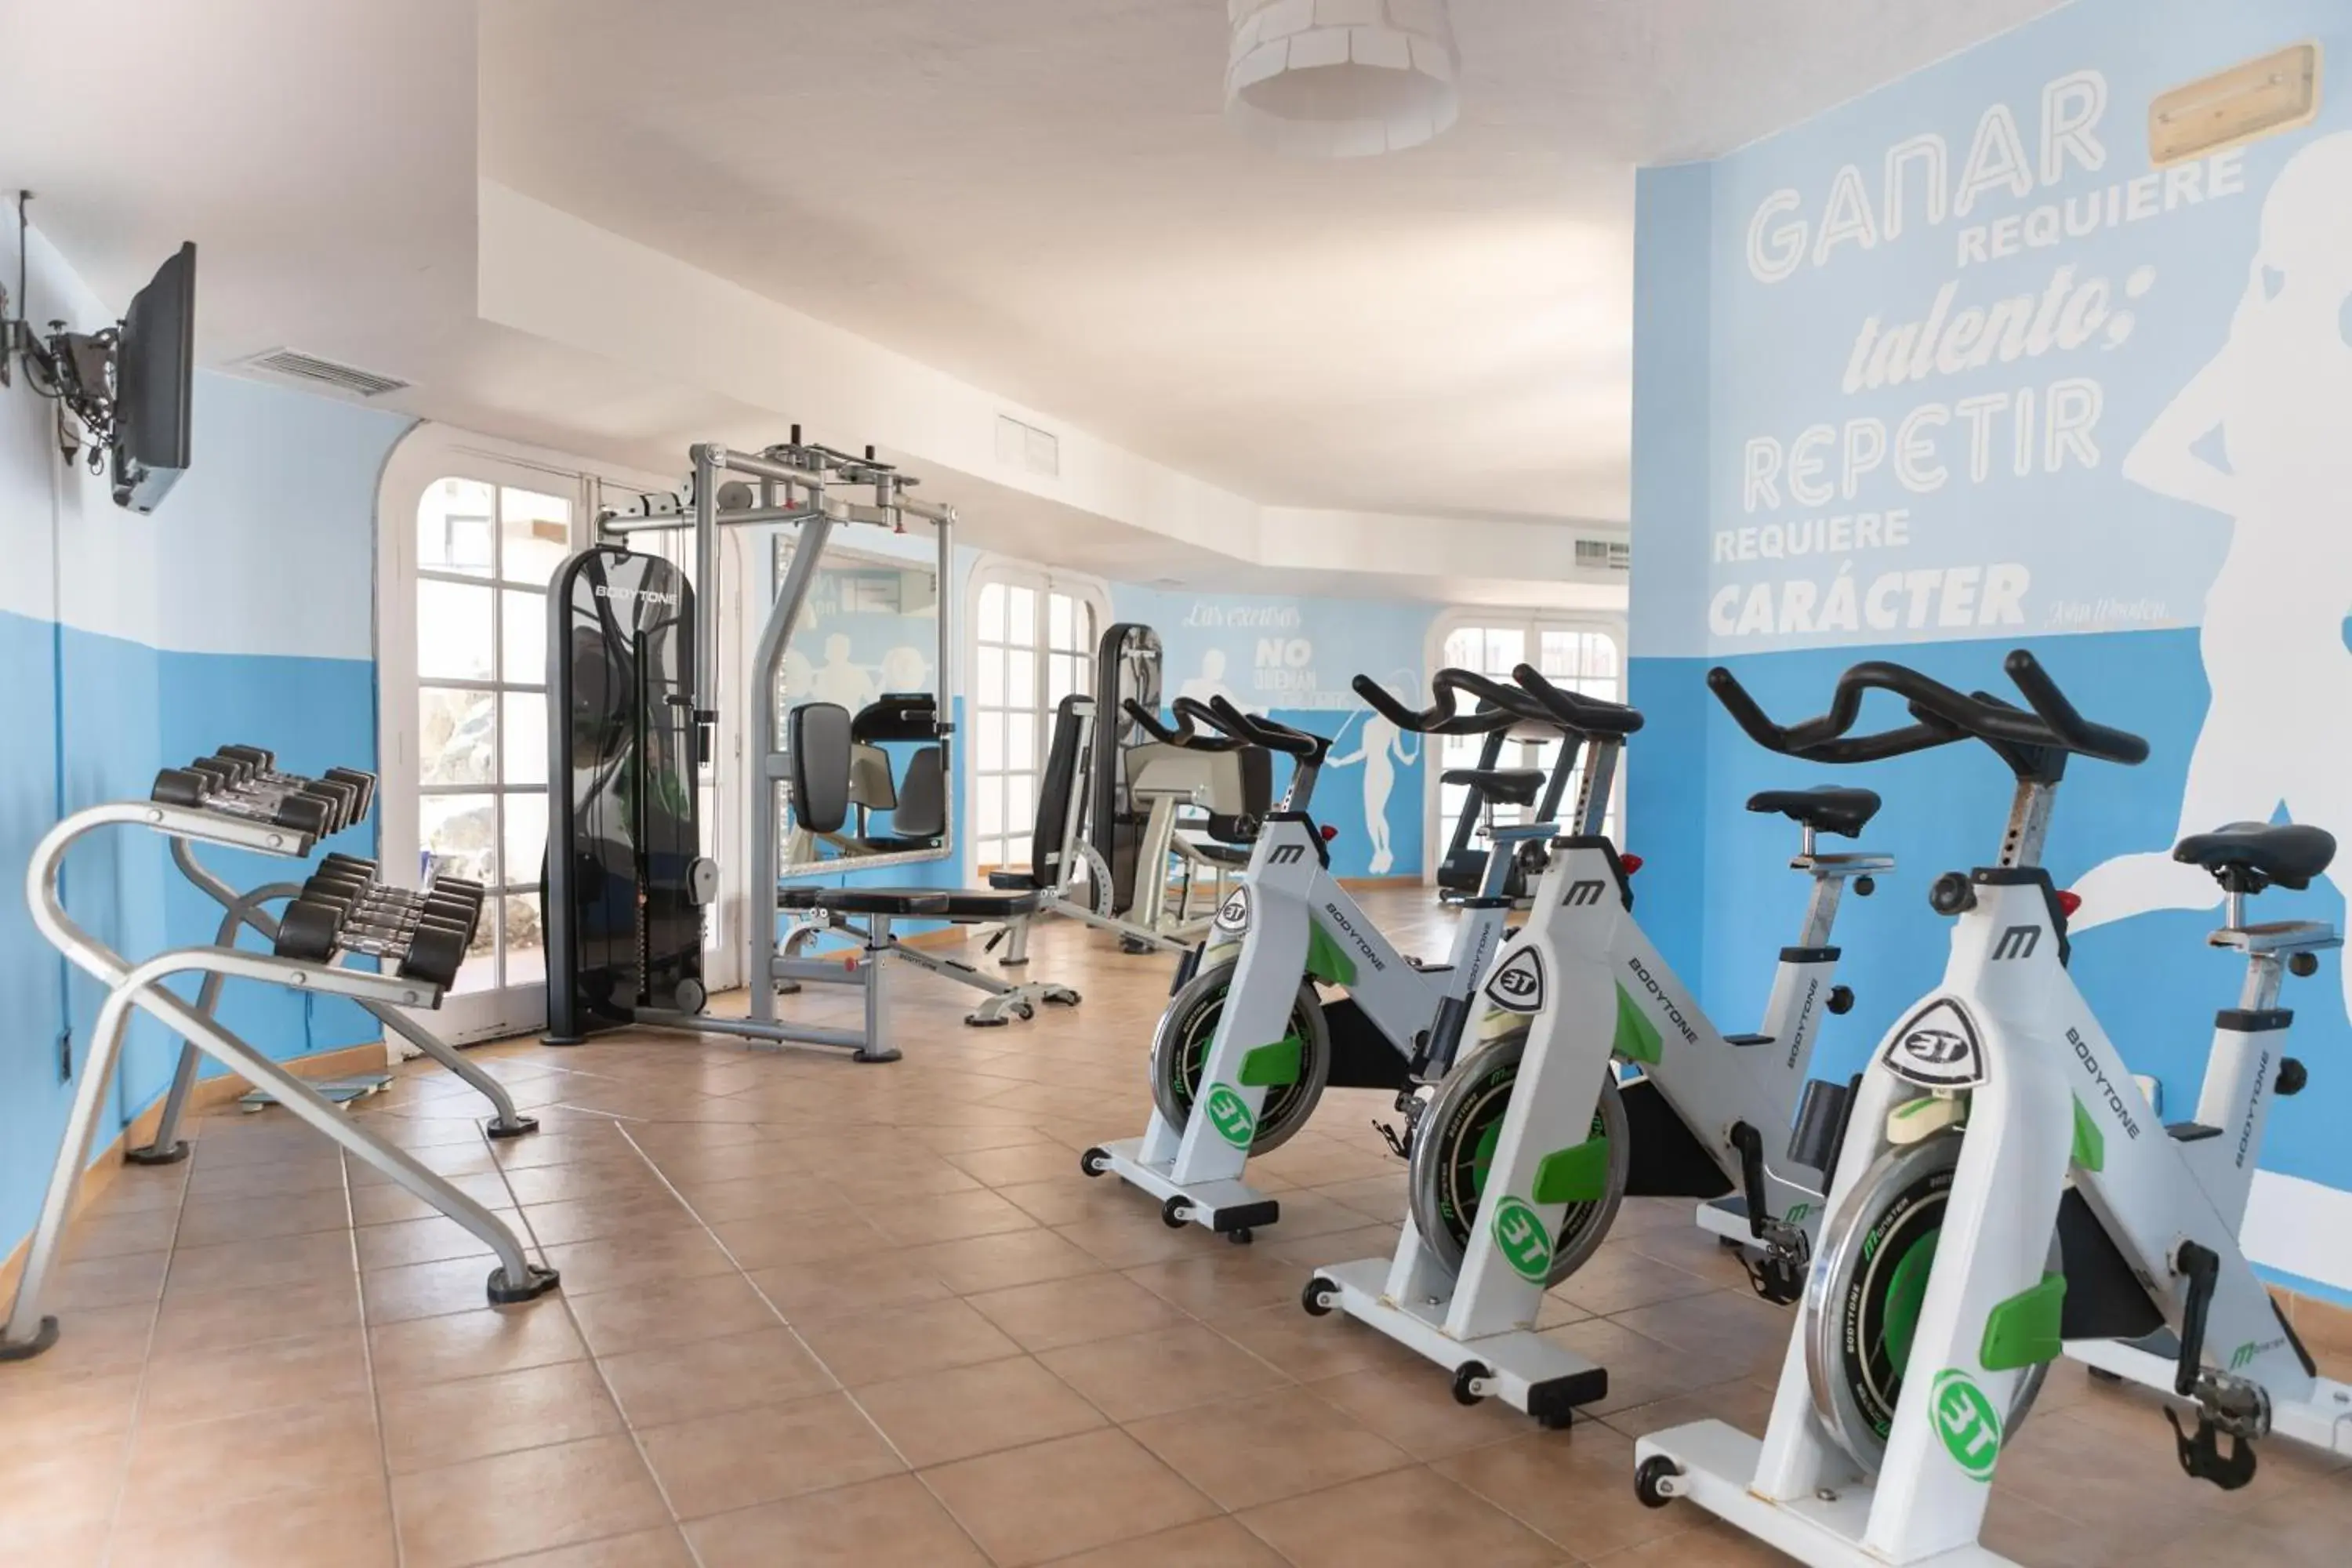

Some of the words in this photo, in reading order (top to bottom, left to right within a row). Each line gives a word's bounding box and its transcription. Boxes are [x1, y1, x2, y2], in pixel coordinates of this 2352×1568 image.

[1745, 69, 2108, 284] GANAR
[1956, 146, 2247, 268] REQUIERE
[1743, 377, 2104, 514] REPETIR
[1713, 509, 1911, 564] REQUIERE
[595, 585, 678, 605] BODYTONE
[1708, 560, 2031, 637] CARÁCTER
[1255, 637, 1312, 668] NO
[1325, 902, 1387, 972] BODYTONE
[1628, 956, 1700, 1045] BODYTONE
[1787, 978, 1819, 1069] BODYTONE
[2065, 1026, 2141, 1140] BODYTONE
[2235, 1050, 2270, 1170] BODYTONE
[1846, 1283, 1860, 1354] BODYTONE
